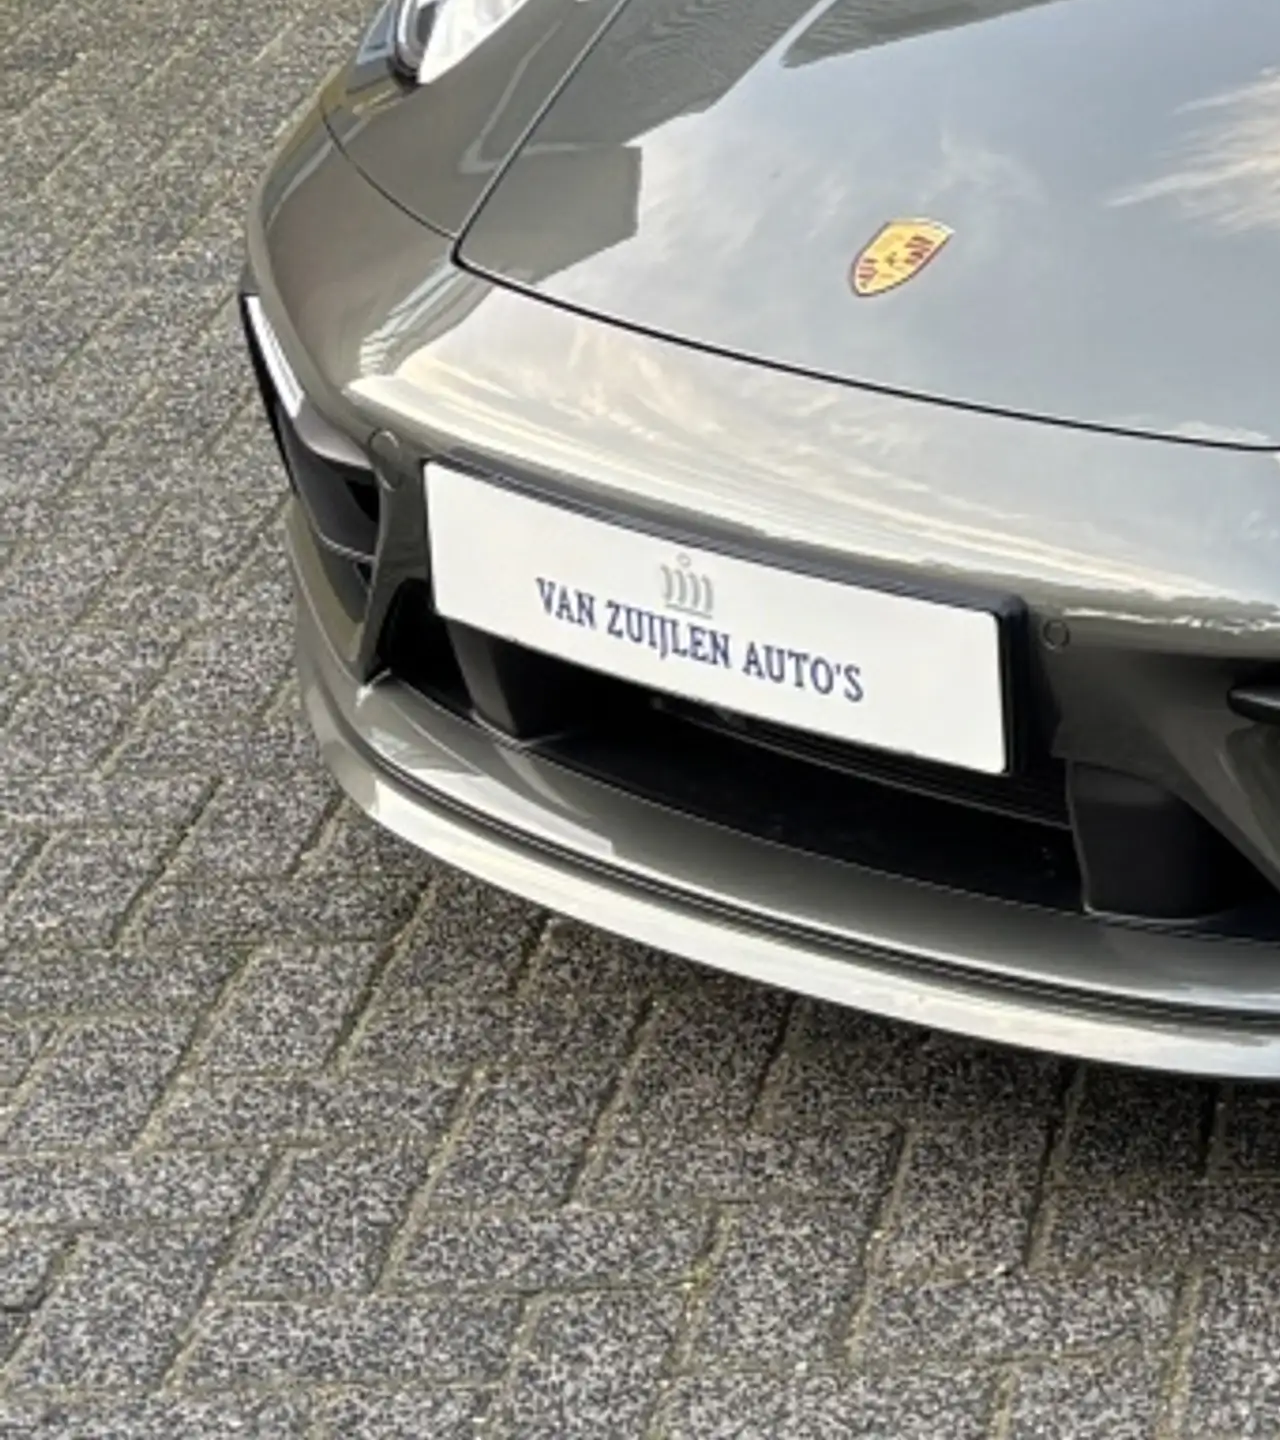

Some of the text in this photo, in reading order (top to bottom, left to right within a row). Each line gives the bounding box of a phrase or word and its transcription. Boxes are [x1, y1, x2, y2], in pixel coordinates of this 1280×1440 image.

[535, 577, 863, 702] VAN ZUIJLEN AUTO'S
